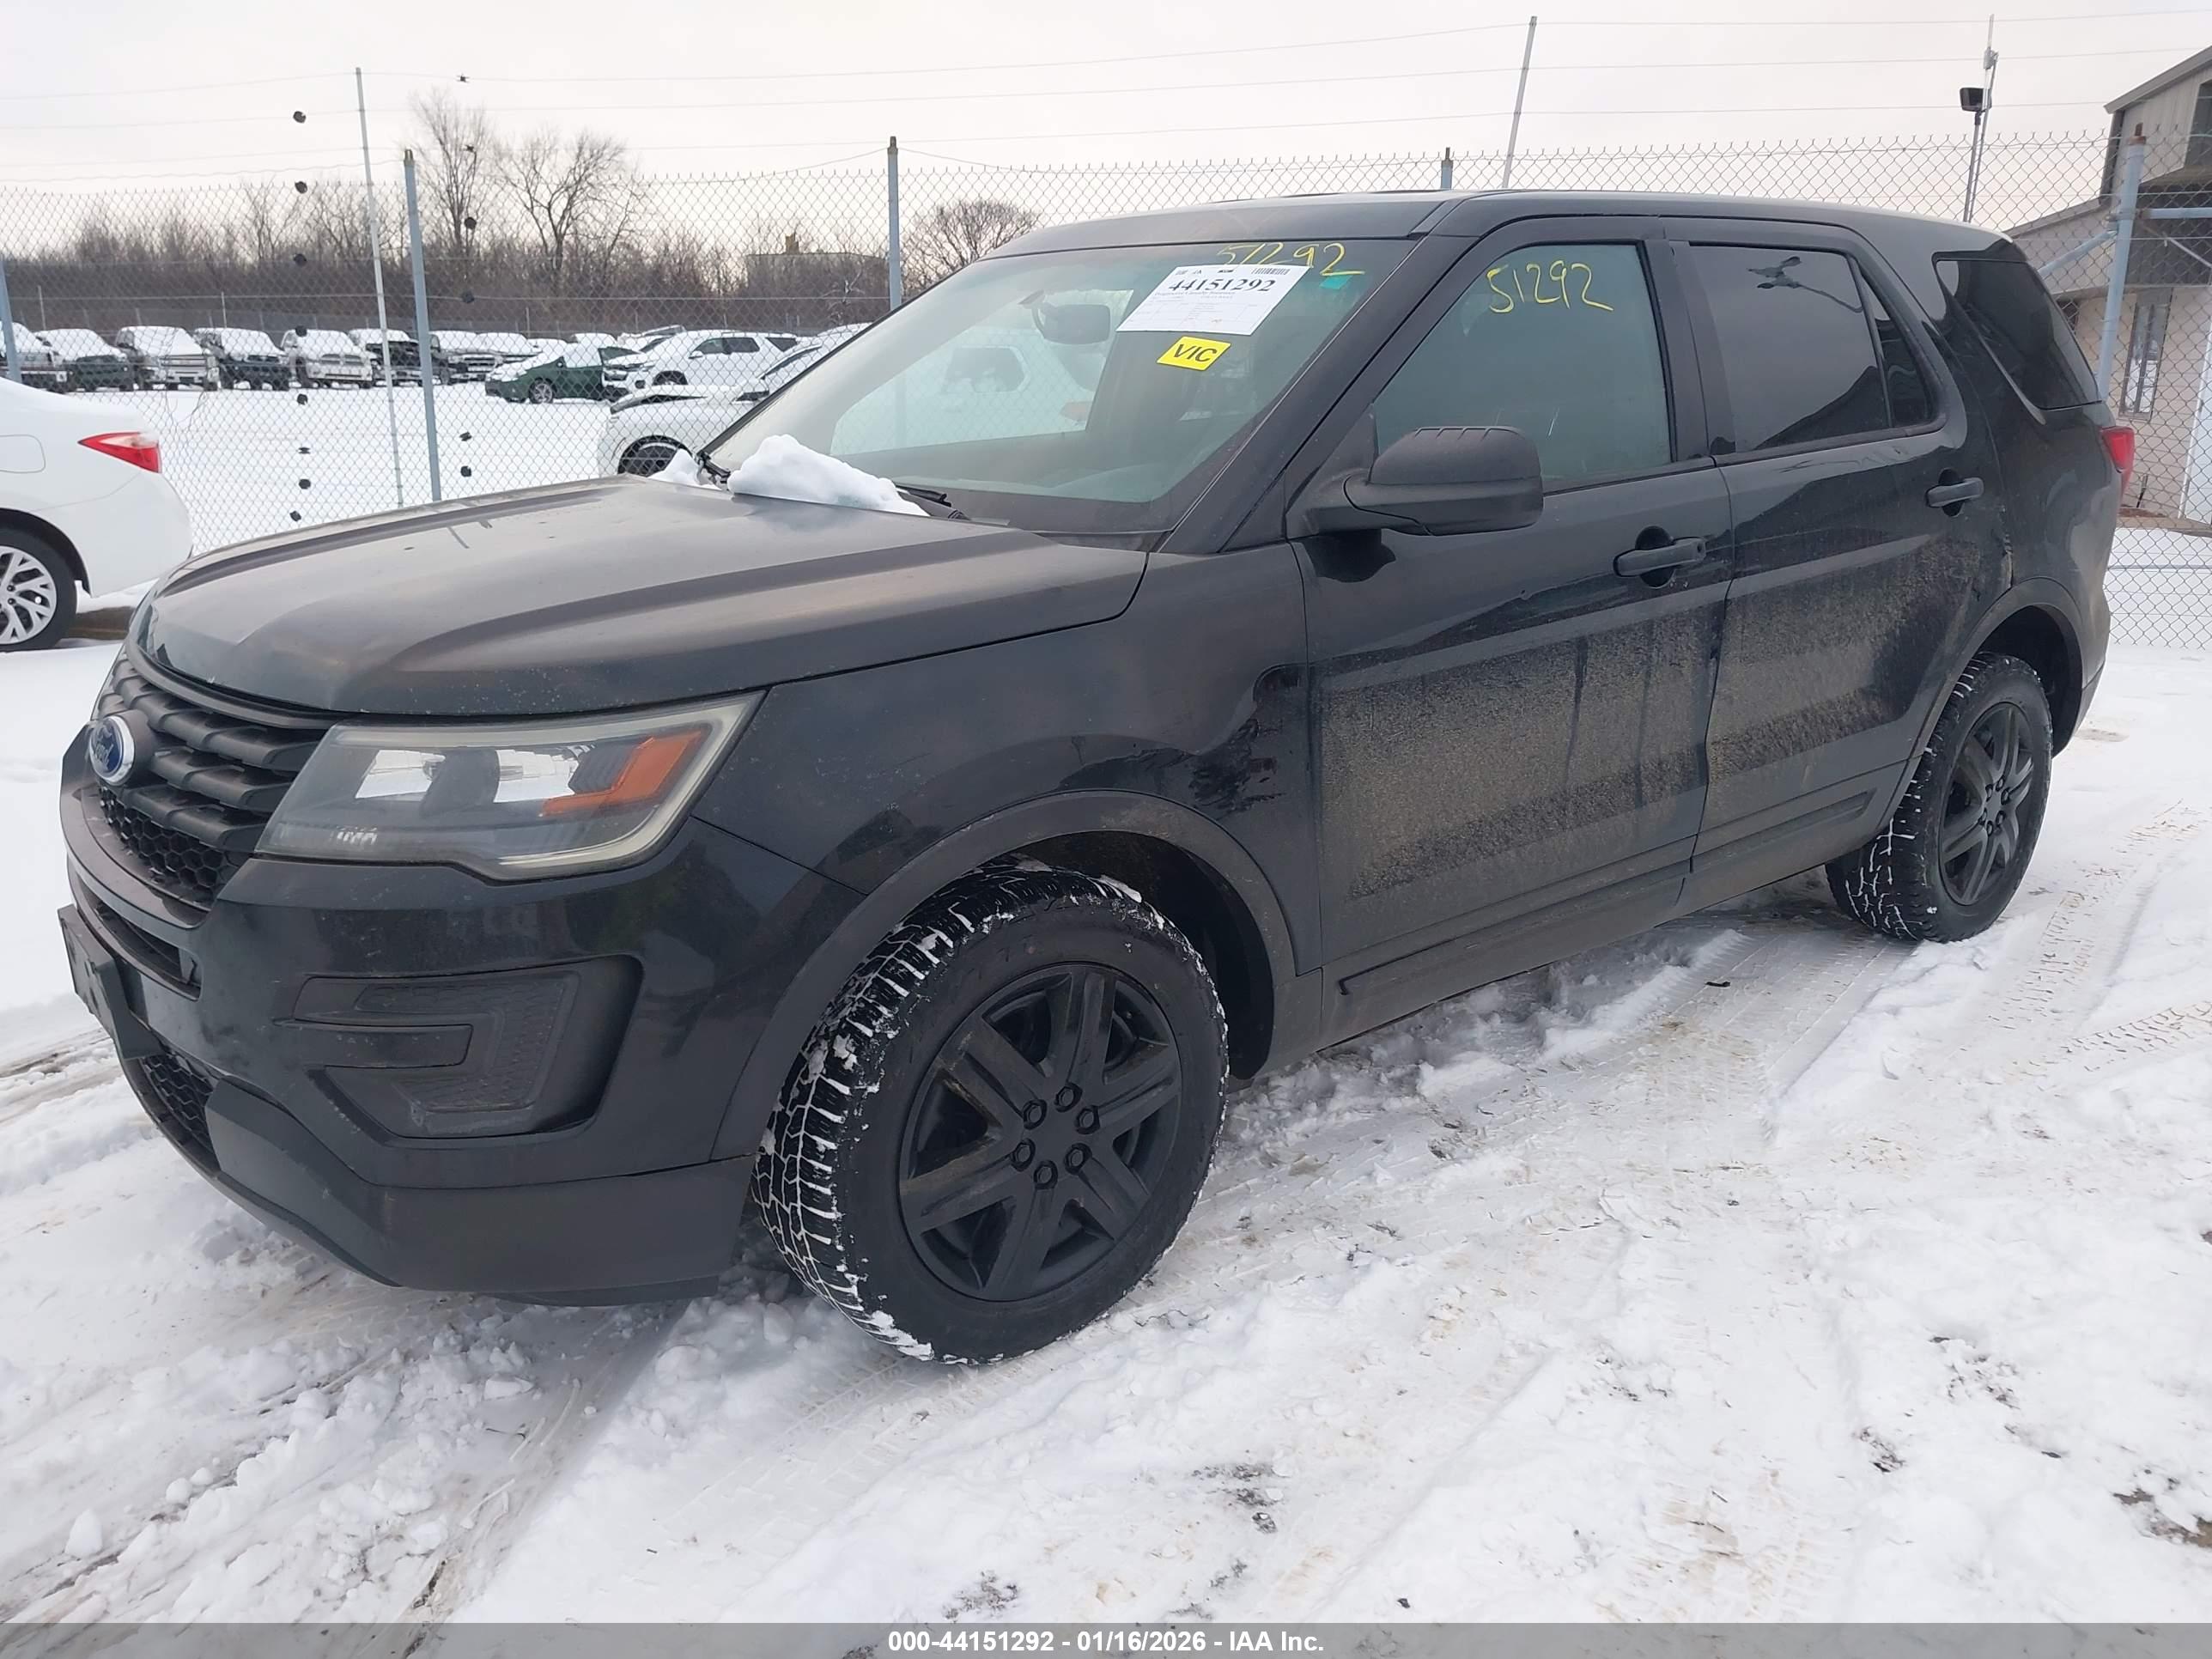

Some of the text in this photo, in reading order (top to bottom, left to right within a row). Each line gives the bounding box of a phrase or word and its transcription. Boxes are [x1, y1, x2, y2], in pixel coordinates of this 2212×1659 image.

[1216, 242, 1365, 276] 51292
[1169, 278, 1277, 292] 44151292
[1486, 259, 1614, 313] 51292
[1173, 343, 1218, 362] VIC
